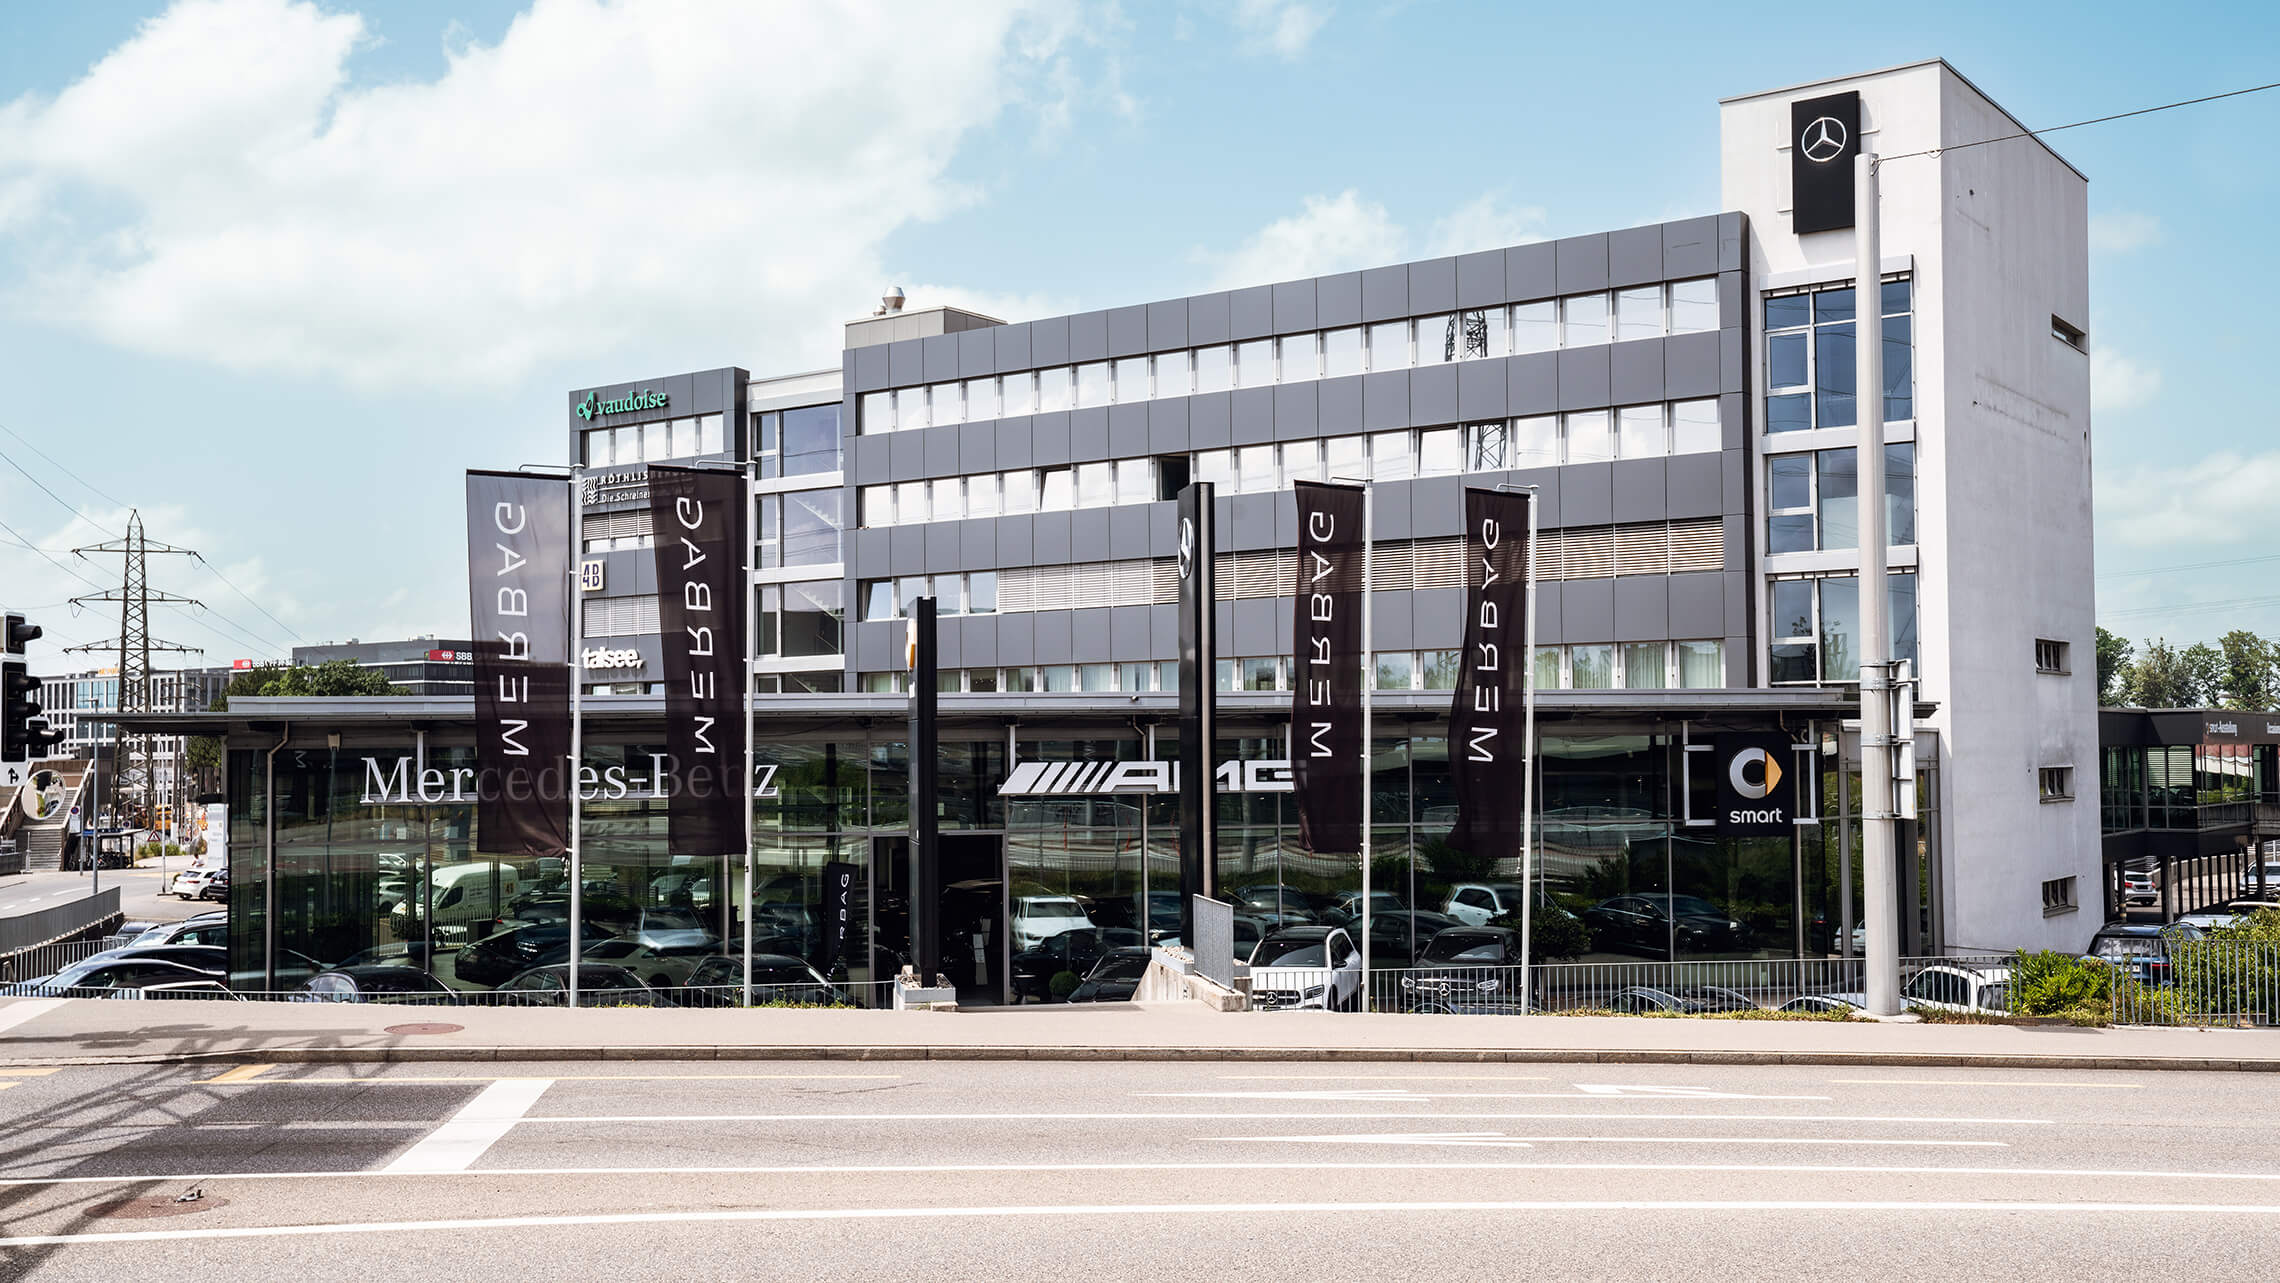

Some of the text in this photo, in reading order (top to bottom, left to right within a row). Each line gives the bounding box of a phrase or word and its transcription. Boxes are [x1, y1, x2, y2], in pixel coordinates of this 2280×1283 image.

[597, 389, 667, 415] vaudoise
[601, 494, 614, 503] Die
[582, 563, 600, 588] 4B
[1730, 808, 1783, 823] smart
